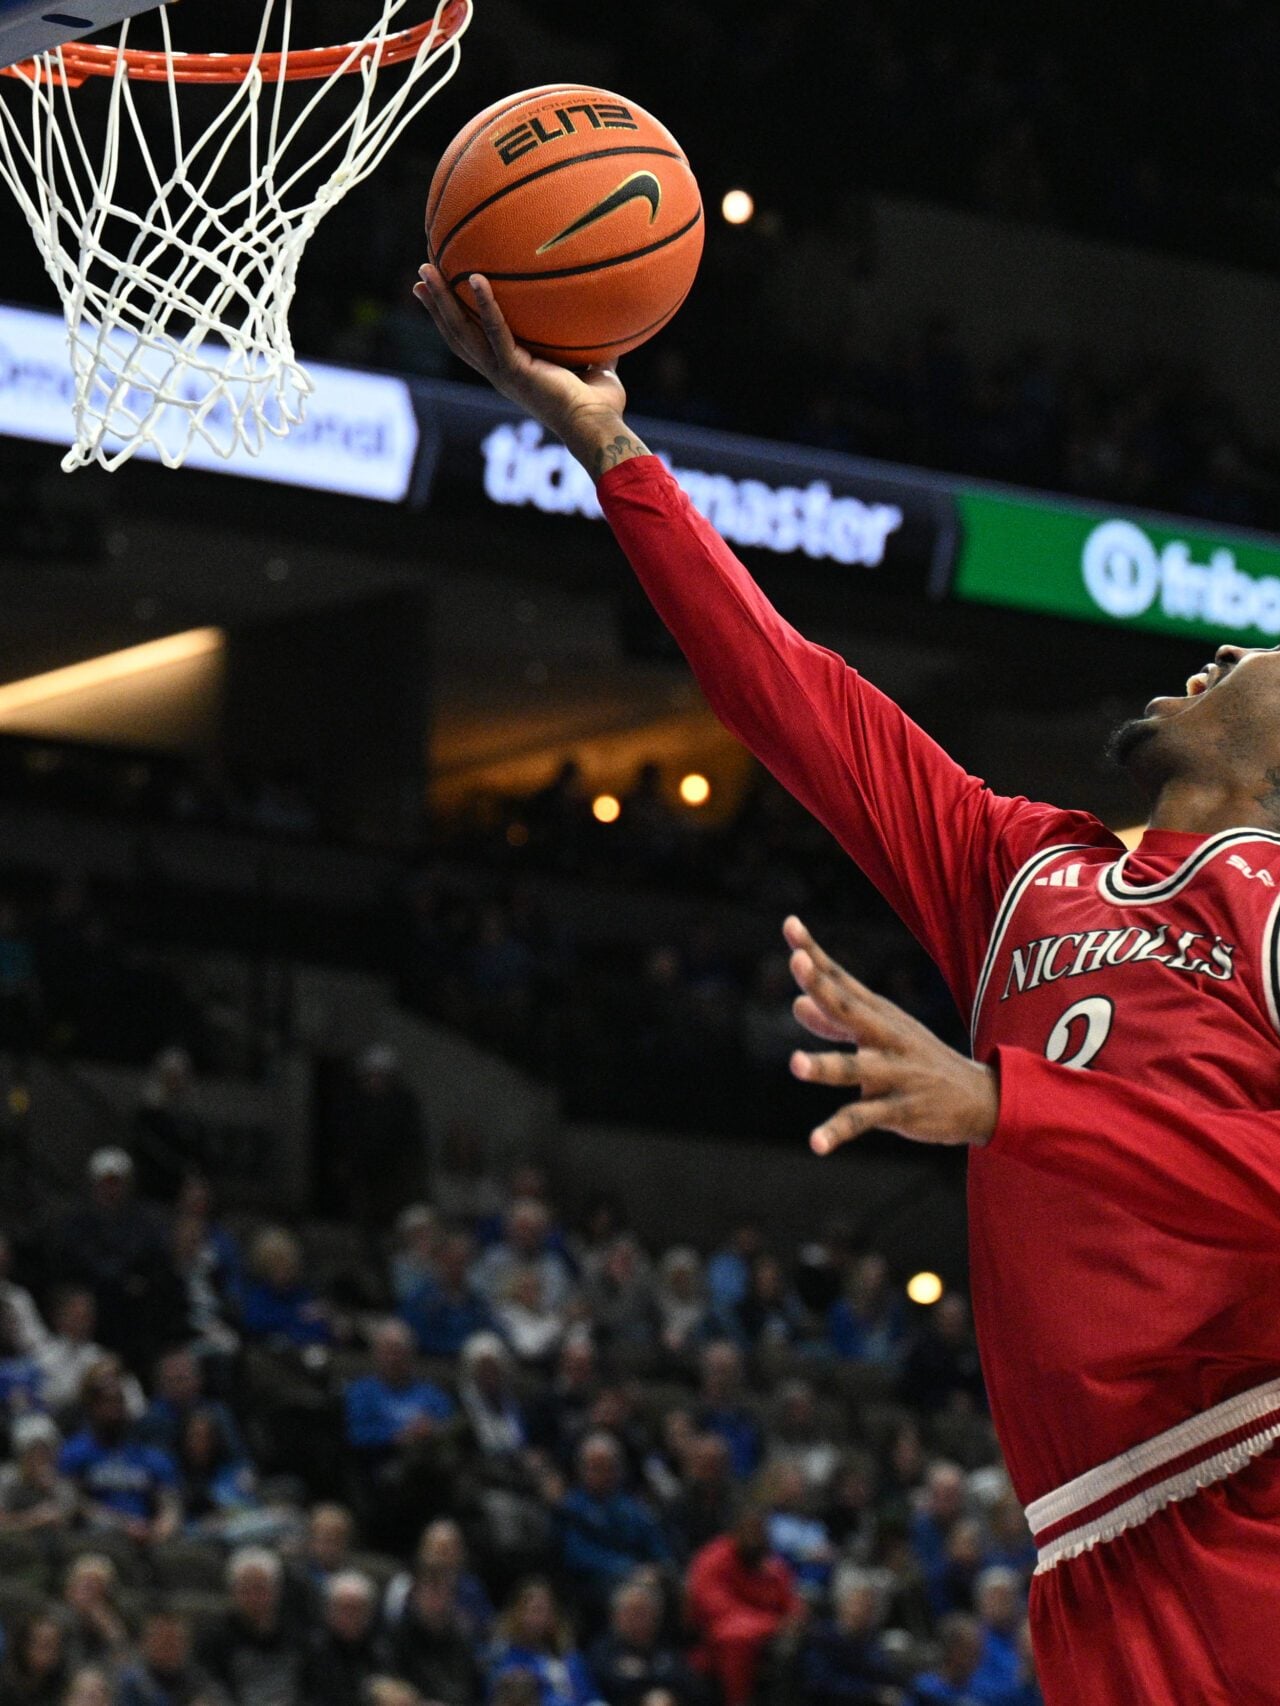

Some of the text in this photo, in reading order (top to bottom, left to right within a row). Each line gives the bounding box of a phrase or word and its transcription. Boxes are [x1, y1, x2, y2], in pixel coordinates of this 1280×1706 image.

[495, 103, 639, 166] ELITE
[481, 420, 902, 567] ticmaster
[1001, 923, 1236, 1000] NICHOLLS
